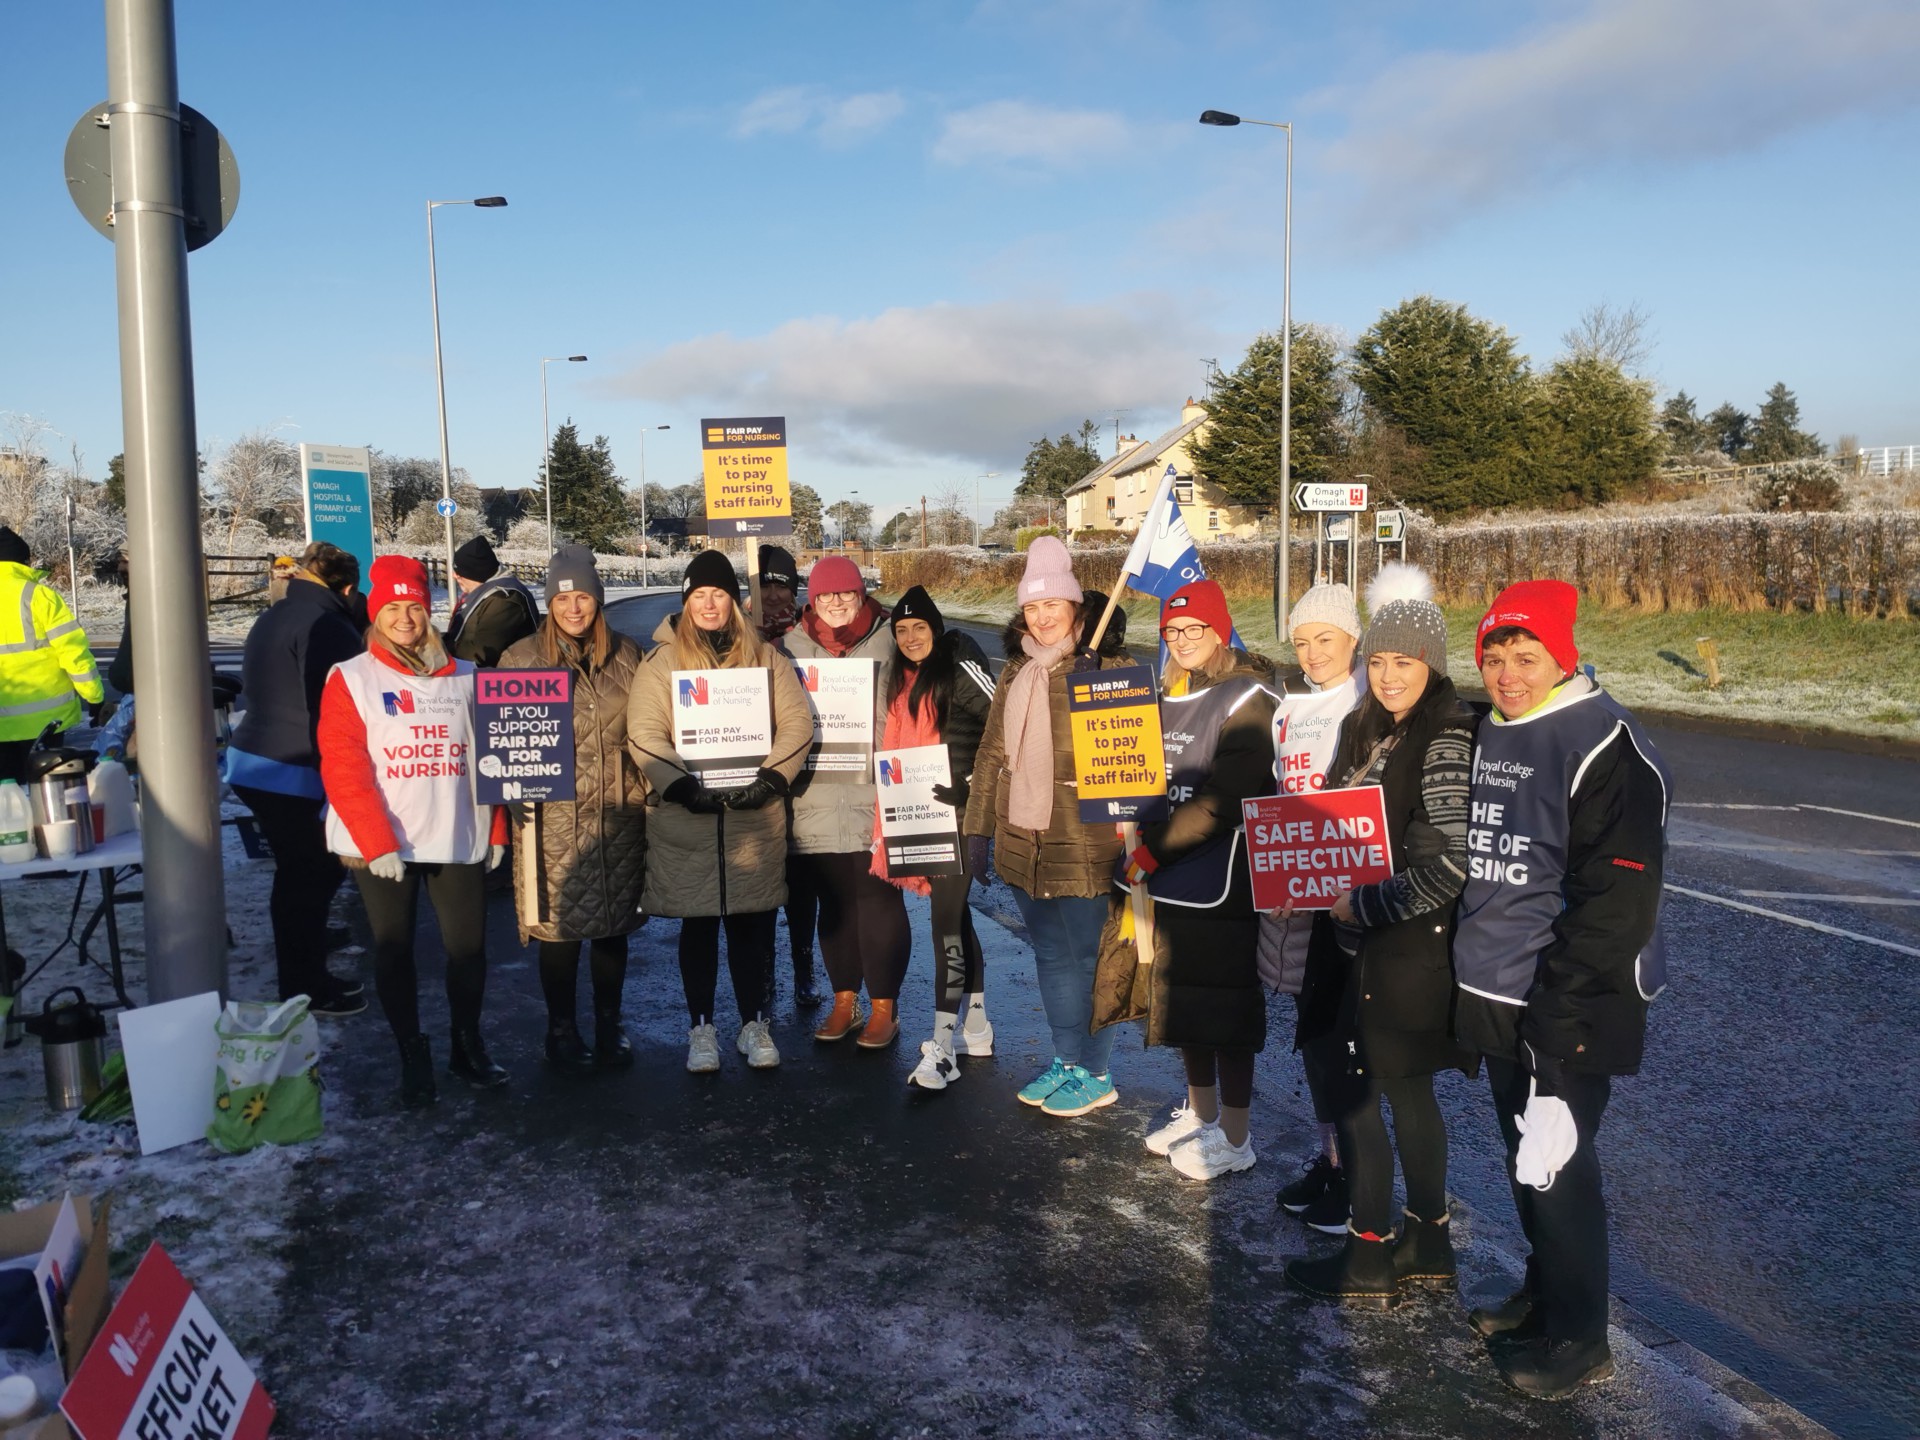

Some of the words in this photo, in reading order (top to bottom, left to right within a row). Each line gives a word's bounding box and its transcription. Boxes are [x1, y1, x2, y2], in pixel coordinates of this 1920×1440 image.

[718, 455, 738, 466] It's
[742, 454, 772, 465] time
[726, 470, 740, 479] to
[744, 470, 767, 481] pay
[312, 482, 340, 491] OMAGH
[722, 482, 773, 494] nursing
[1314, 488, 1345, 497] Omagh
[314, 493, 344, 502] HOSPITAL
[714, 497, 745, 508] staff
[748, 496, 782, 508] fairly
[1312, 498, 1347, 507] Hospital
[314, 504, 344, 512] PRIMARY
[315, 514, 347, 522] COMPLEX
[1379, 515, 1396, 523] Belfast
[904, 605, 912, 615] L
[822, 675, 840, 684] Royal
[842, 676, 867, 685] College
[1092, 682, 1112, 692] FAIR
[1112, 680, 1130, 690] PAY
[484, 679, 562, 697] HONK
[712, 686, 733, 697] Royal
[735, 685, 762, 696] College
[831, 685, 857, 695] Nursing
[1094, 692, 1110, 700] FOR
[1112, 687, 1150, 698] NURSING
[417, 696, 438, 707] Royal
[439, 696, 463, 707] College
[713, 696, 721, 705] of
[723, 696, 752, 706] Nursing
[419, 706, 427, 714] of
[428, 706, 455, 716] Nursing
[500, 707, 513, 719] IF
[516, 706, 549, 718] YOU
[488, 720, 560, 734] SUPPORT
[1086, 718, 1107, 731] It's
[1110, 715, 1143, 729] time
[1288, 720, 1304, 731] Royal
[1305, 716, 1332, 727] College
[410, 725, 449, 740] THE
[698, 728, 721, 736] FAIR
[1172, 732, 1195, 744] College
[1288, 732, 1294, 741] of
[1295, 730, 1321, 740] Nursing
[489, 735, 526, 749] FAIR
[530, 734, 560, 748] PAY
[699, 736, 719, 744] FOR
[722, 734, 764, 743] NURSING
[1095, 737, 1109, 749] to
[1113, 736, 1138, 750] pay
[384, 744, 444, 760] VOICE
[453, 744, 468, 758] OF
[1164, 741, 1183, 754] ursing
[509, 750, 542, 762] FOR
[1092, 751, 1145, 767] nursing
[1280, 752, 1311, 773] THE
[387, 762, 466, 779] NURSING
[490, 763, 562, 778] URSING
[905, 765, 922, 774] Royal
[922, 764, 944, 774] College
[1502, 761, 1534, 778] College
[906, 775, 913, 783] of
[914, 774, 937, 783] Nursing
[1084, 771, 1116, 785] staff
[1120, 768, 1157, 785] fairly
[1309, 772, 1326, 790] O
[1485, 774, 1517, 792] Nursing
[1169, 785, 1193, 801] OF
[916, 804, 930, 812] PAY
[1472, 801, 1504, 826] HE
[915, 811, 950, 820] NURSING
[1254, 822, 1315, 845] SAFE
[1321, 816, 1375, 840] AND
[1499, 833, 1531, 856] OF
[1254, 844, 1385, 873] EFFECTIVE
[1288, 875, 1352, 898] CARE
[136, 1318, 218, 1440] FFICIAL
